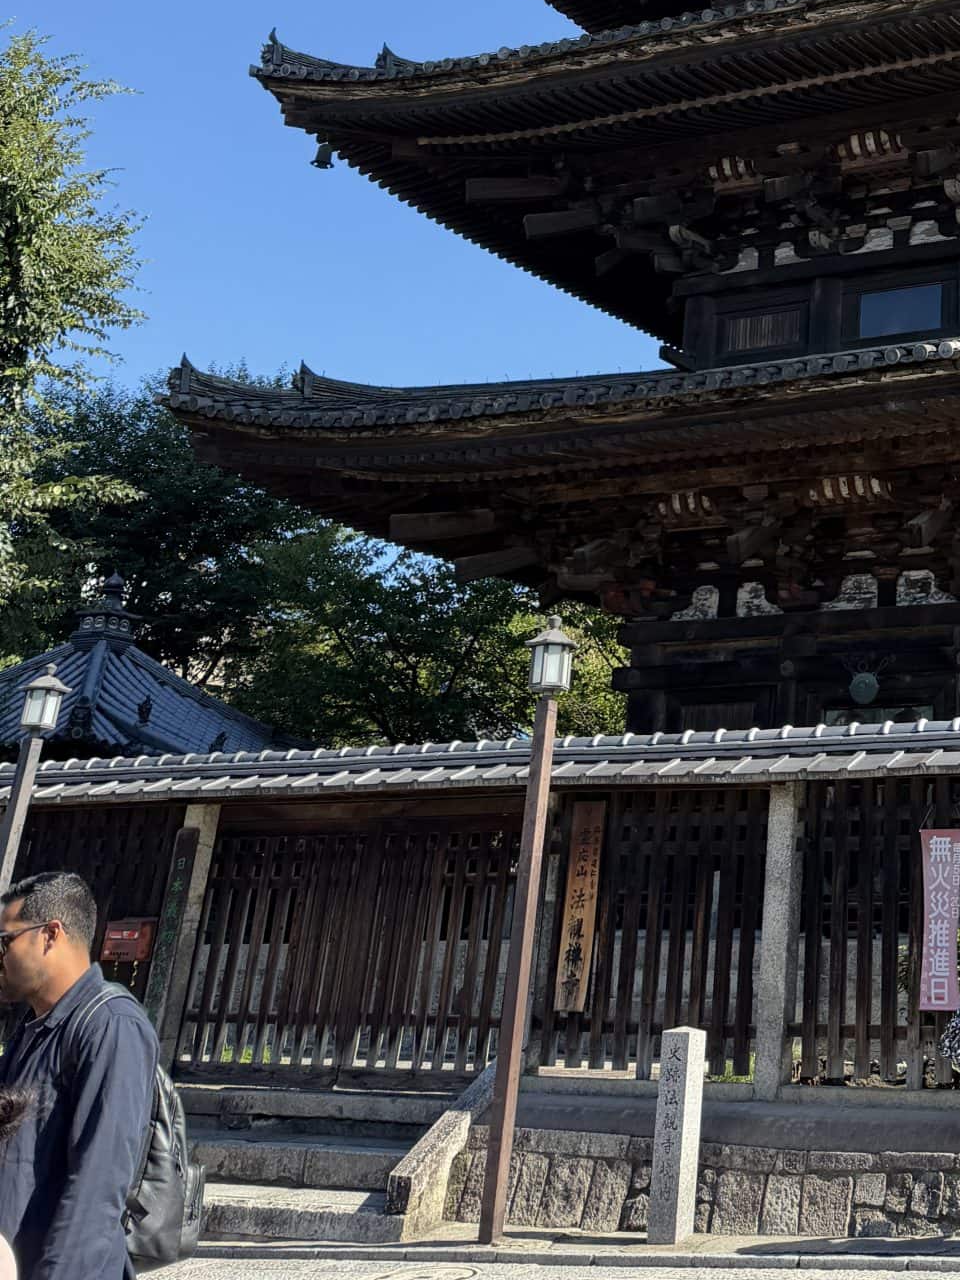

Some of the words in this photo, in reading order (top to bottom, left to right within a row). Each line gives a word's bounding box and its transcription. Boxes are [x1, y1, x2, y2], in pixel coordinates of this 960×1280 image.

[928, 835, 952, 1006] 無火災推進日
